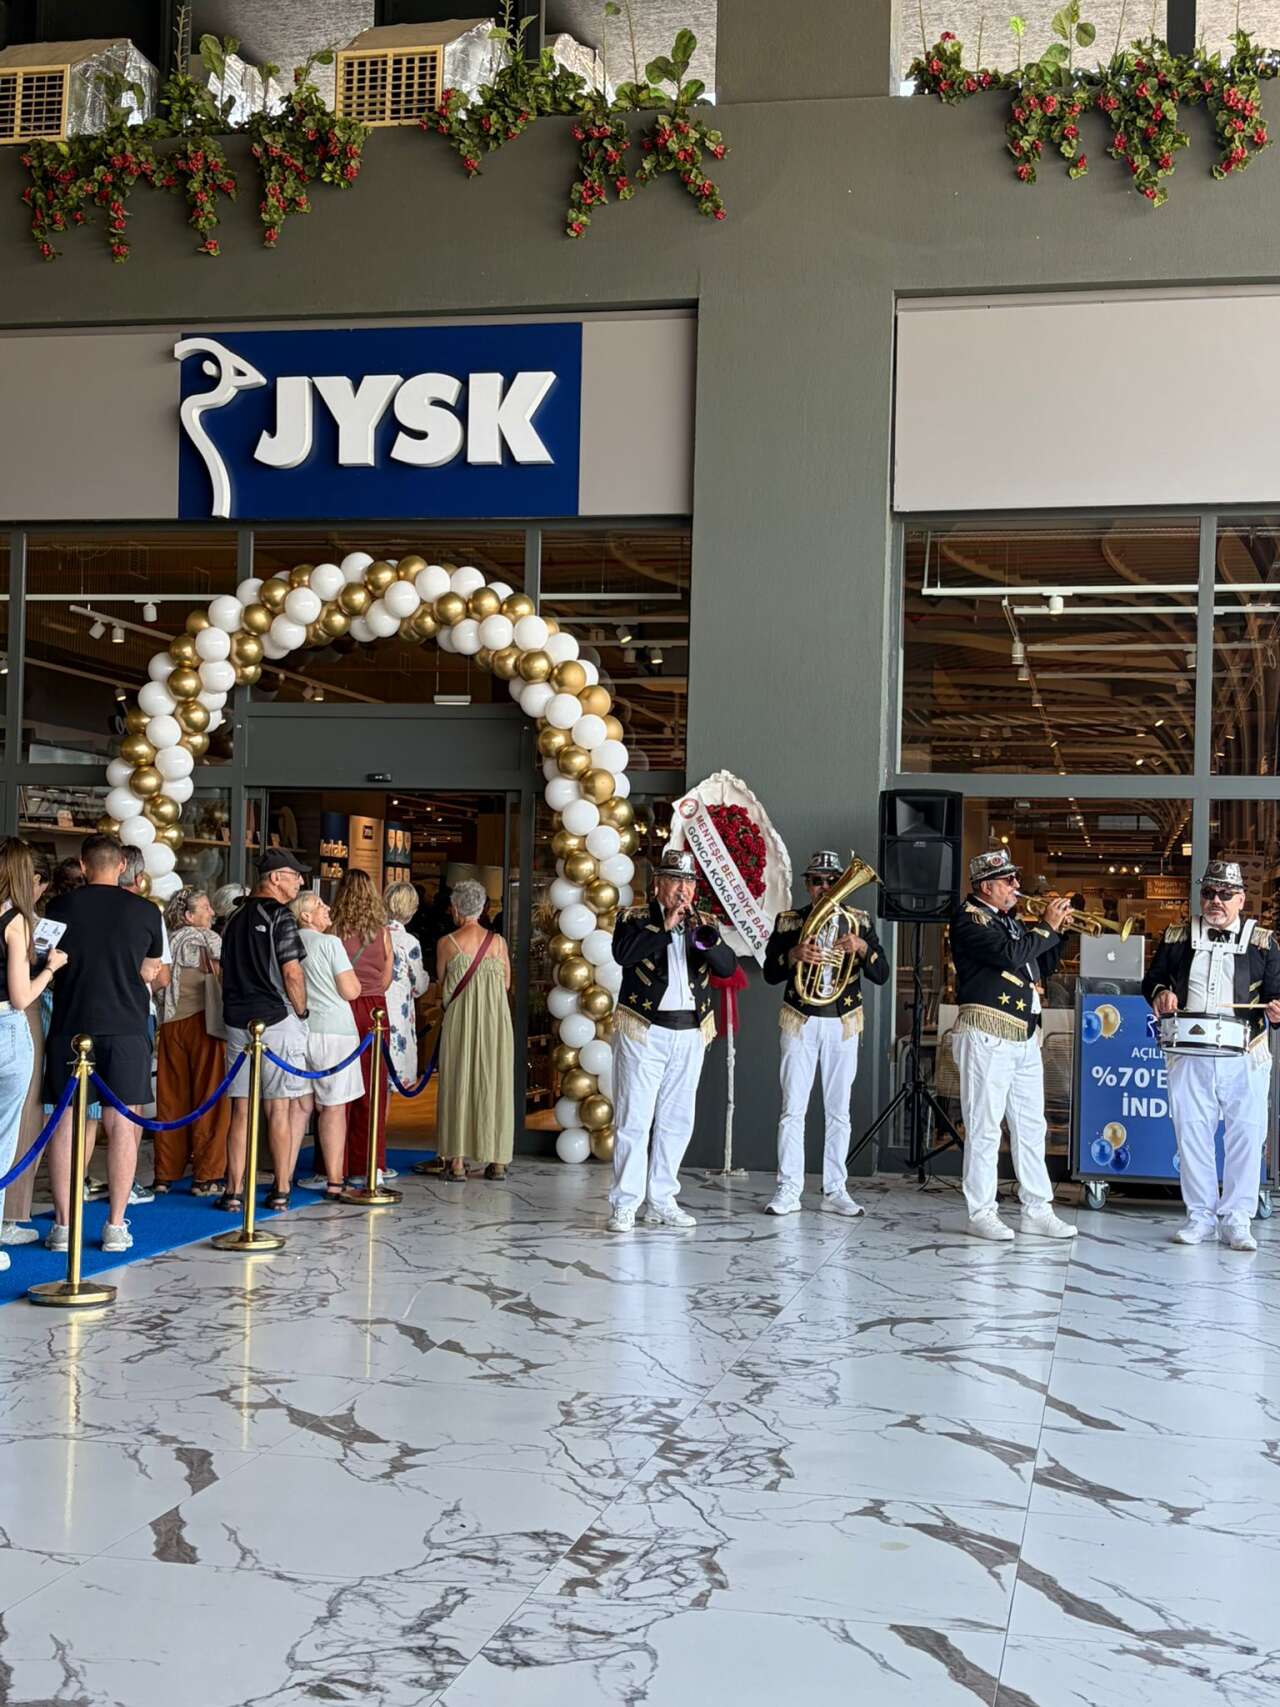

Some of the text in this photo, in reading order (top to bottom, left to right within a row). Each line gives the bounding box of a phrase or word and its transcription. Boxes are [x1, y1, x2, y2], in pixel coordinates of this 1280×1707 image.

[254, 371, 557, 468] JYSK
[688, 826, 762, 950] GONCA KÖKSAL ARAS
[696, 815, 770, 943] MENTEŞE BELEDİYE BAŞ
[1091, 1066, 1168, 1089] %70'E
[1131, 1047, 1165, 1061] AÇILI
